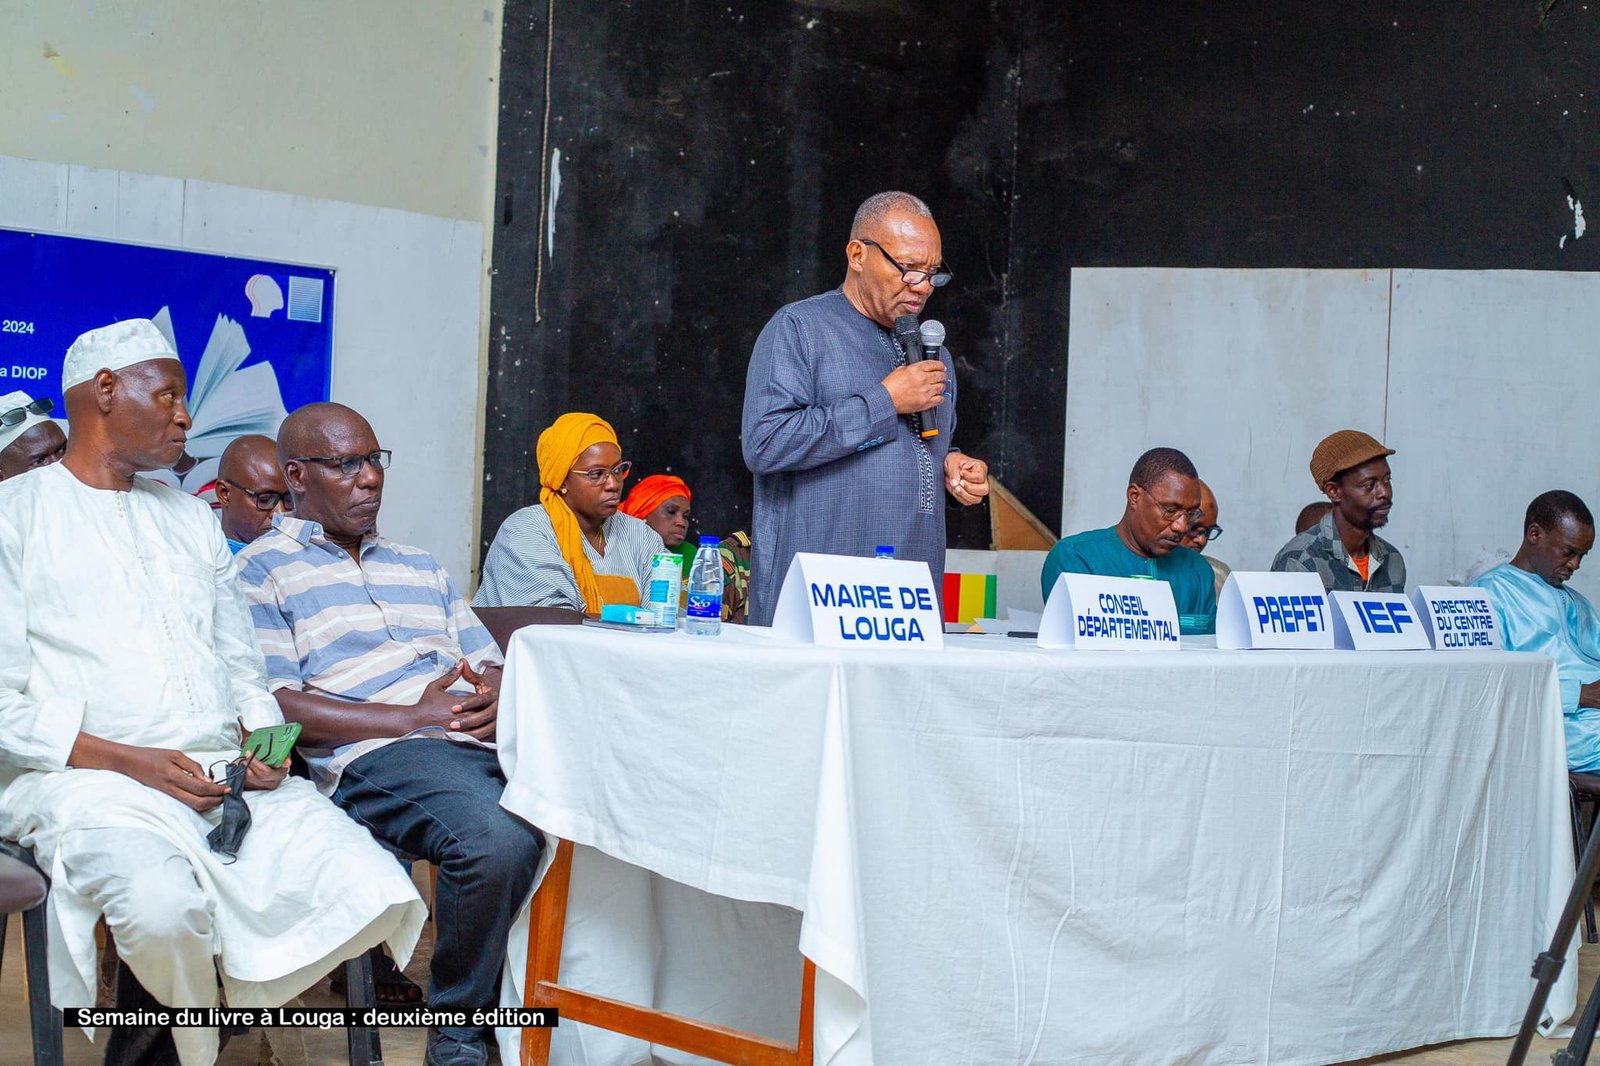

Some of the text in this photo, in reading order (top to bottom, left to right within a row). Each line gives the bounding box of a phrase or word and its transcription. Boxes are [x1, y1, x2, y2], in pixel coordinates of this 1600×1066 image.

[2, 319, 35, 335] 2024
[11, 365, 48, 380] DIOP
[811, 582, 933, 611] MAIRE DE
[1098, 593, 1149, 617] CONSEIL
[1431, 600, 1490, 614] DIRECTRICE
[1078, 608, 1178, 642] DÉPARTEMENTAL
[1252, 595, 1326, 634] PREFET
[1353, 601, 1413, 634] IEF
[1436, 615, 1494, 631] DU CENTRE
[839, 616, 925, 642] LOUGA
[1443, 631, 1494, 648] CULTUREL
